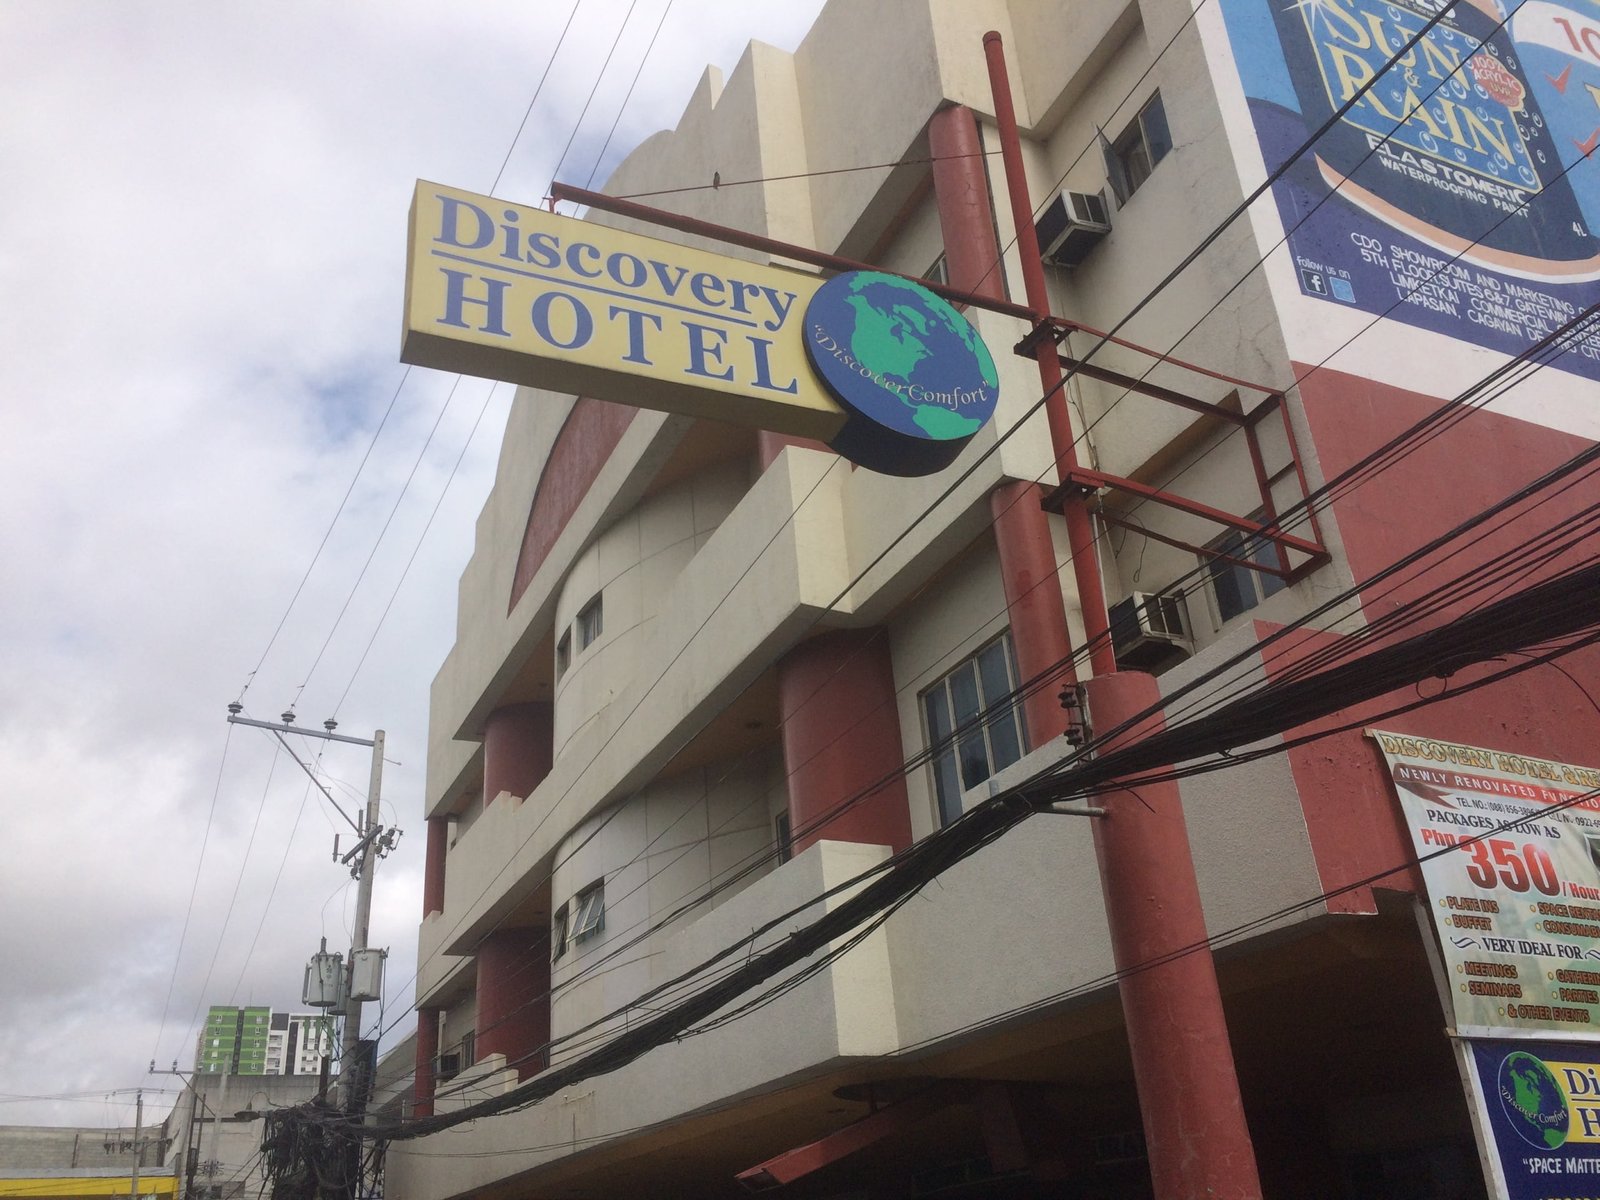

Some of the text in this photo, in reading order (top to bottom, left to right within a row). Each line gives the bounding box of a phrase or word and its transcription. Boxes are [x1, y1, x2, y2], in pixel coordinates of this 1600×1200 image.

[1323, 41, 1516, 165] RAIN
[1366, 133, 1531, 208] ELASTOMERIC
[1379, 155, 1530, 219] WATERPROOFING PAINT
[1572, 220, 1588, 238] 4L
[432, 194, 798, 332] Discovery
[1296, 255, 1324, 272] Follow
[1338, 269, 1352, 280] on
[1350, 232, 1383, 253] CDO
[1390, 244, 1472, 282] SHOWROOM
[1476, 272, 1501, 291] AND
[1504, 281, 1576, 315] MARKETING
[1360, 248, 1390, 269] 5TH
[1515, 299, 1569, 326] GATEWAY
[1389, 271, 1461, 304] LIMKETKAI
[1470, 297, 1554, 334] COMMERCIAL
[436, 267, 799, 396] HOTEL
[1467, 309, 1523, 337] CAGAYAN
[1380, 733, 1494, 770] DISCOVERY
[1492, 752, 1562, 783] HOTEL
[1399, 767, 1448, 785] NEWLY
[1454, 775, 1536, 798] RENOVATED
[1426, 809, 1494, 830] PACKAGES
[1543, 825, 1561, 839] AS
[1458, 834, 1560, 897] 350
[1446, 896, 1499, 914] PLATE INS
[1537, 901, 1569, 918] SPACE
[1452, 915, 1492, 931] BUFFET
[1482, 937, 1584, 960] VERY IDEAL FOR
[1464, 961, 1518, 979] MEETINGS
[1469, 981, 1522, 998] SEMINARS
[1559, 987, 1599, 1004] PARTIES
[1518, 1004, 1552, 1021] OTHER
[1552, 1006, 1590, 1023] EVENTS
